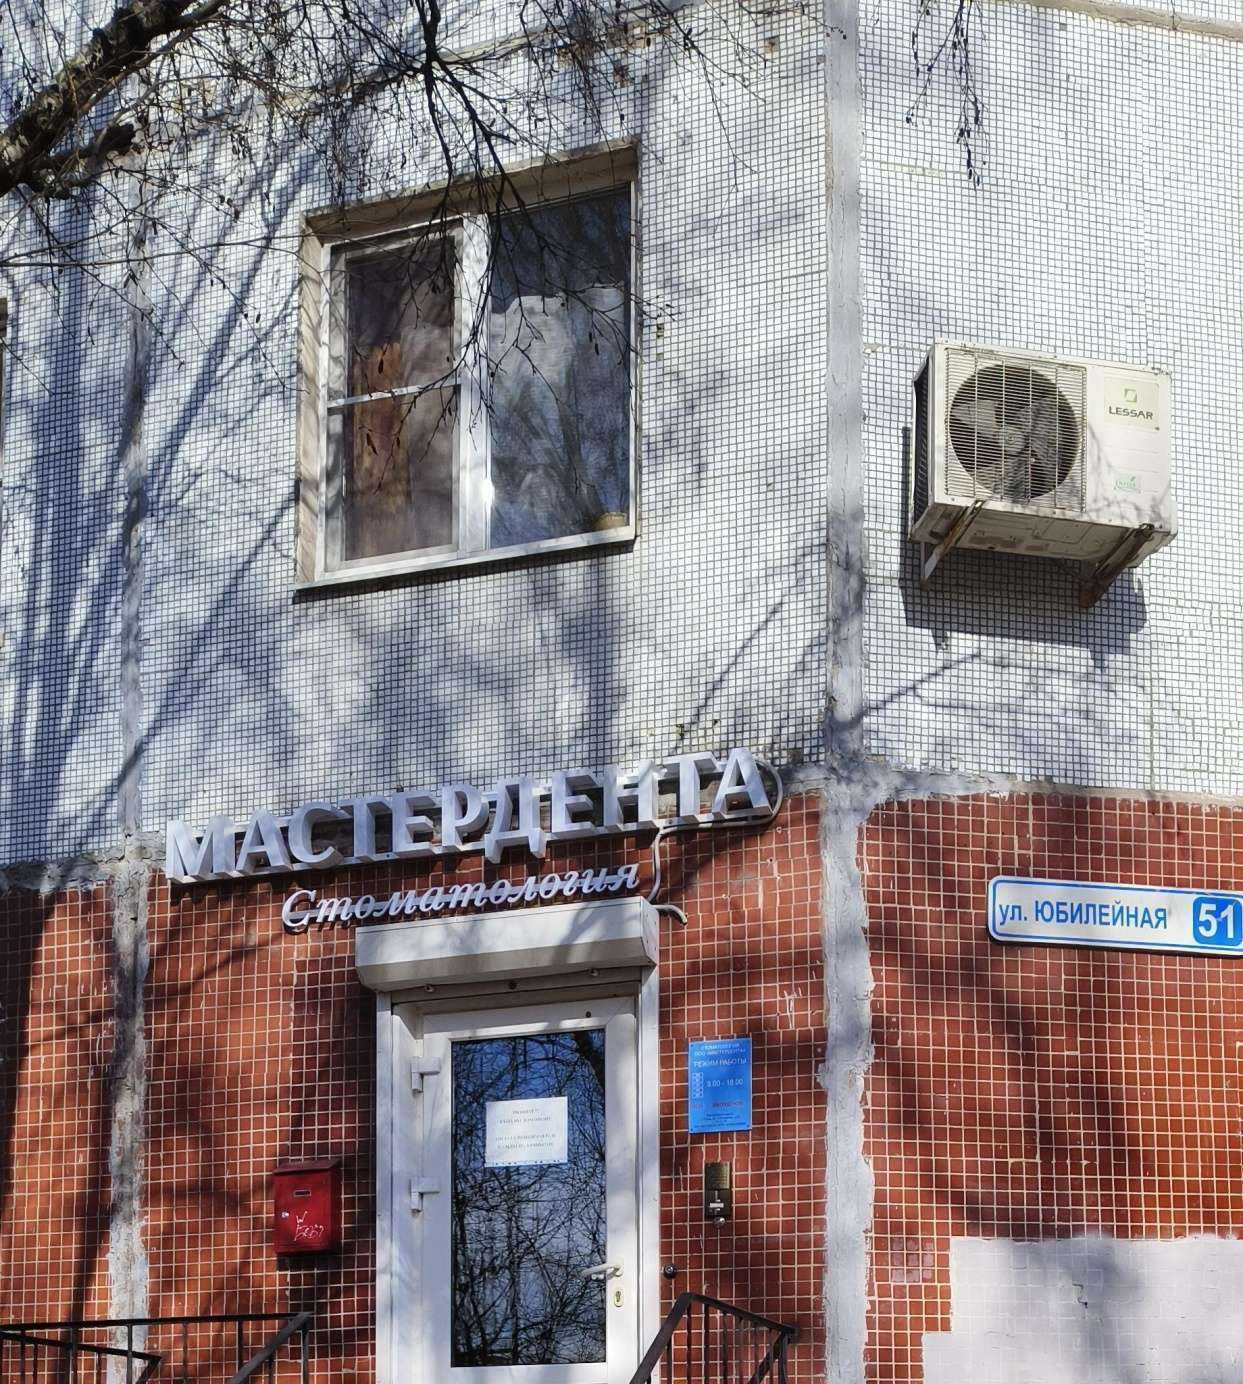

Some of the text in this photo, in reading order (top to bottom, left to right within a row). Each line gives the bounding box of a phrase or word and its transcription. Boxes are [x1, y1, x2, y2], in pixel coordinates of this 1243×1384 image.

[1109, 405, 1154, 421] LESSAR
[165, 746, 775, 885] МАСТЕРДЕНТА
[281, 860, 641, 932] Стоматология
[999, 899, 1236, 940] ул. ЮБИЛЕЙНАЯ 51
